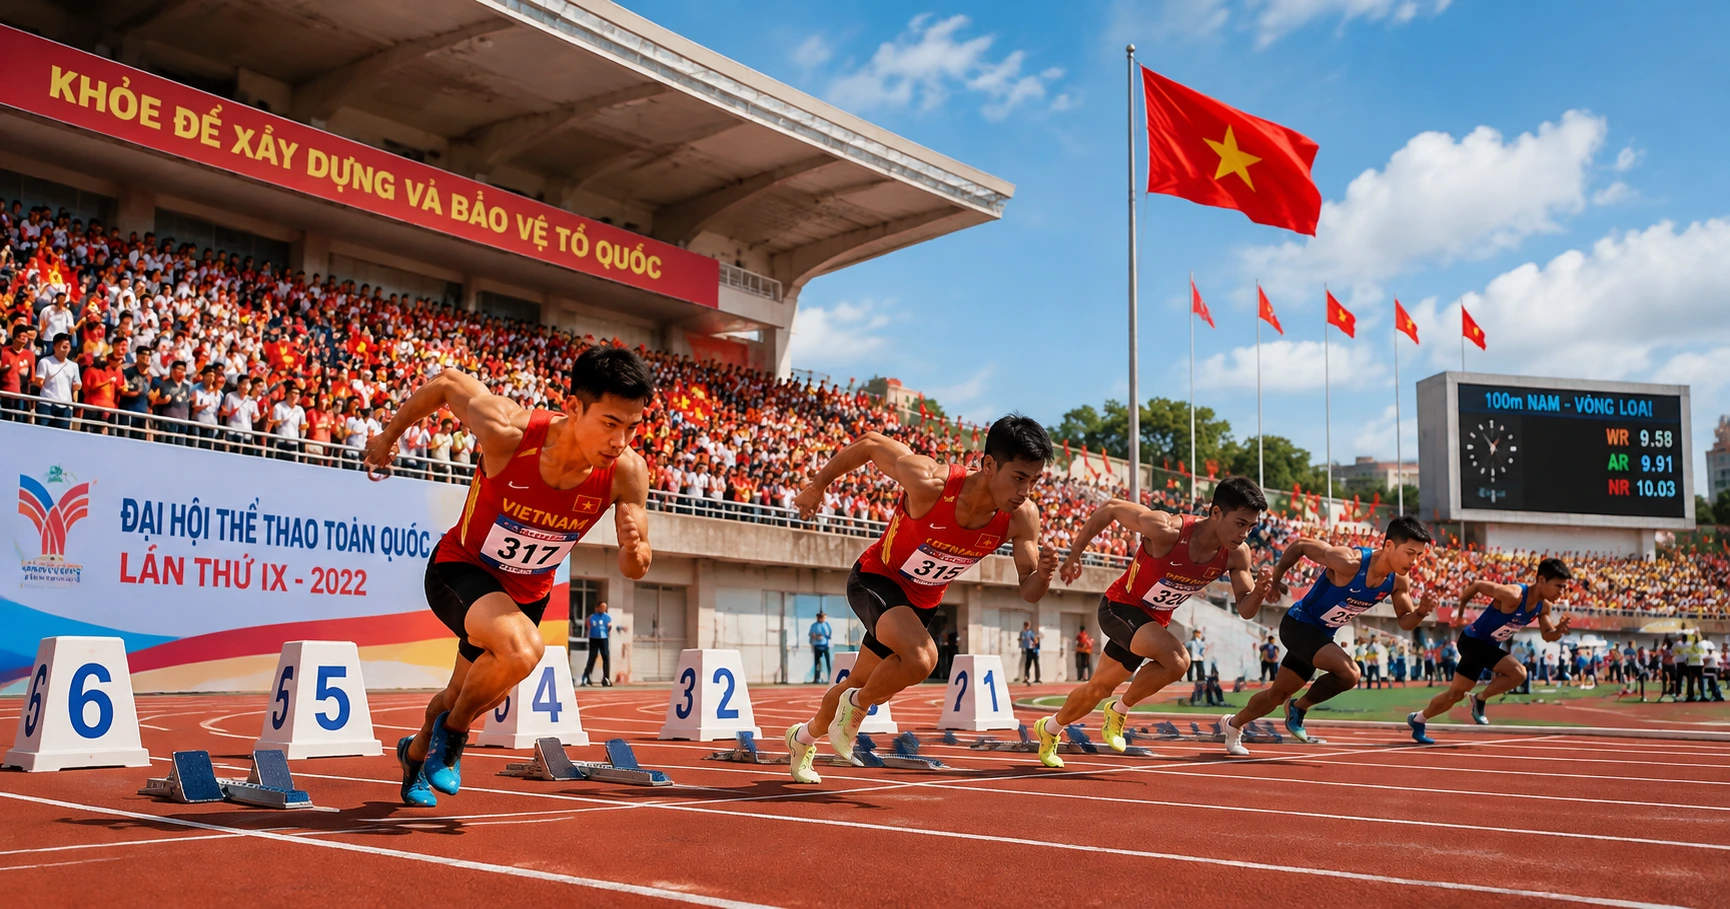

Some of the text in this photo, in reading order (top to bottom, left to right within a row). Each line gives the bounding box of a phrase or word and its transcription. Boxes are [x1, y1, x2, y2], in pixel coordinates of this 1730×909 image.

[49, 65, 162, 130] KHỎE
[173, 104, 222, 149] ĐỂ
[307, 147, 395, 200] DỰNG
[516, 214, 549, 252] VỆ
[555, 223, 589, 258] TỔ
[595, 240, 662, 280] QUỐC
[1485, 391, 1523, 410] 100m
[1527, 393, 1560, 412] NAM
[1606, 428, 1673, 448] WR 9.58
[1607, 453, 1673, 473] AR 9.91
[1608, 478, 1676, 498] NR 10.03
[120, 497, 163, 542] ĐẠI
[170, 497, 210, 547] HỘI
[216, 497, 260, 544] THỂ
[263, 513, 318, 550] THAO
[502, 497, 589, 531] VIETNAM
[497, 537, 561, 566] 317
[913, 559, 964, 581] 315
[194, 553, 255, 590] THỨ
[261, 563, 289, 592] IX
[310, 566, 367, 597] 2022
[68, 662, 114, 739] 6
[315, 665, 351, 731] 5
[532, 666, 563, 723] 4
[676, 667, 696, 719] 3
[713, 667, 739, 719] 2
[983, 669, 999, 712] 1
